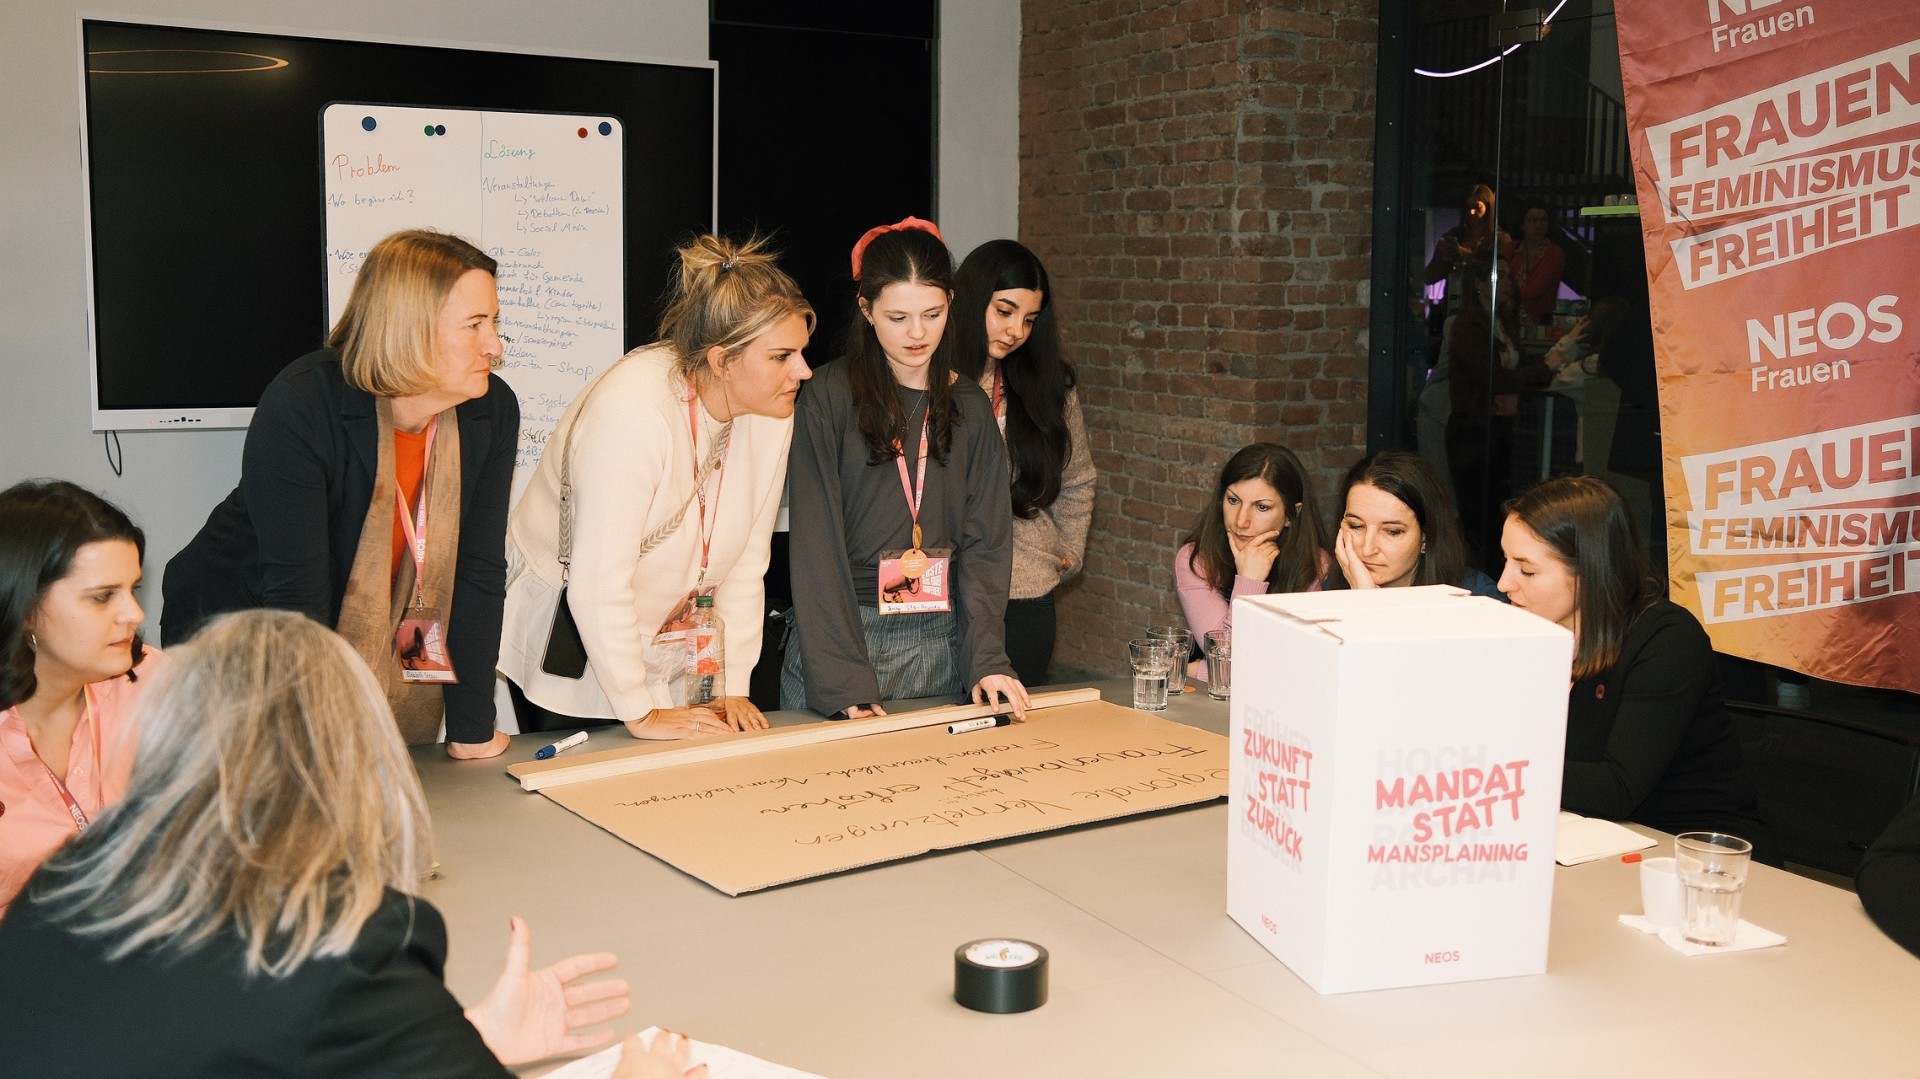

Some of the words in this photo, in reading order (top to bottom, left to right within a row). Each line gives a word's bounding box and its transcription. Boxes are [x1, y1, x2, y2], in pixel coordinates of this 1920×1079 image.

[1711, 5, 1815, 53] Frauen
[1669, 53, 1920, 179] FRAUEN
[332, 153, 400, 180] Problem
[484, 140, 536, 160] Lösung
[1690, 184, 1910, 282] FREIHEIT
[1746, 295, 1903, 363] NEOS
[1751, 359, 1851, 392] Frauen
[538, 393, 571, 412] Syste
[1700, 512, 1920, 550] FEMINISM
[417, 538, 425, 563] NEOS
[1243, 728, 1313, 780] ZUKUNFT
[1072, 767, 1228, 802] egionale
[1258, 771, 1311, 812] STATT
[1375, 759, 1530, 811] MANDAT
[69, 803, 88, 831] NEOS
[794, 798, 1072, 845] Vernetzungen
[1246, 795, 1303, 863] ZURÜCK
[1413, 789, 1525, 843] STATT
[1367, 843, 1529, 864] MANSPLAINING
[1261, 914, 1278, 935] NEOS
[1424, 951, 1461, 965] NEOS
